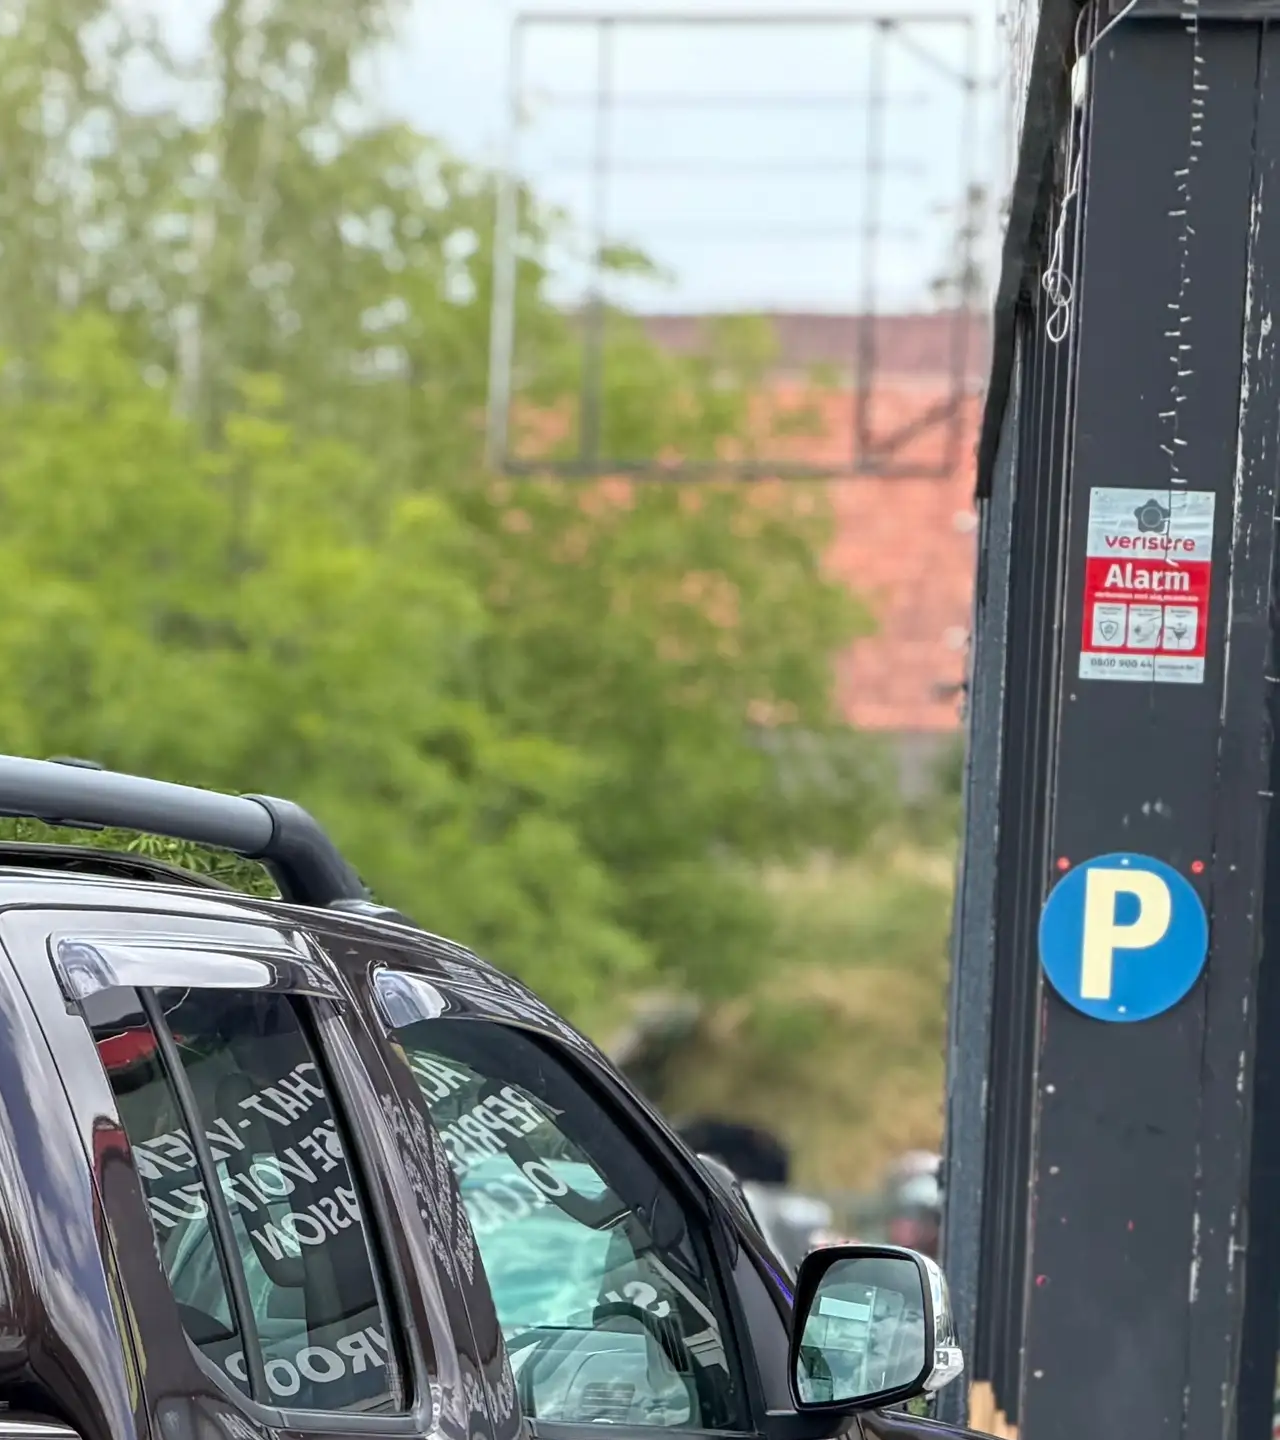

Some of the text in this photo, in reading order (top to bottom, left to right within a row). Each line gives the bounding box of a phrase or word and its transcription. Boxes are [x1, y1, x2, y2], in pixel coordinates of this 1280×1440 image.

[1105, 535, 1196, 552] verisure
[1104, 562, 1190, 592] Alarm
[1080, 868, 1172, 1000] P
